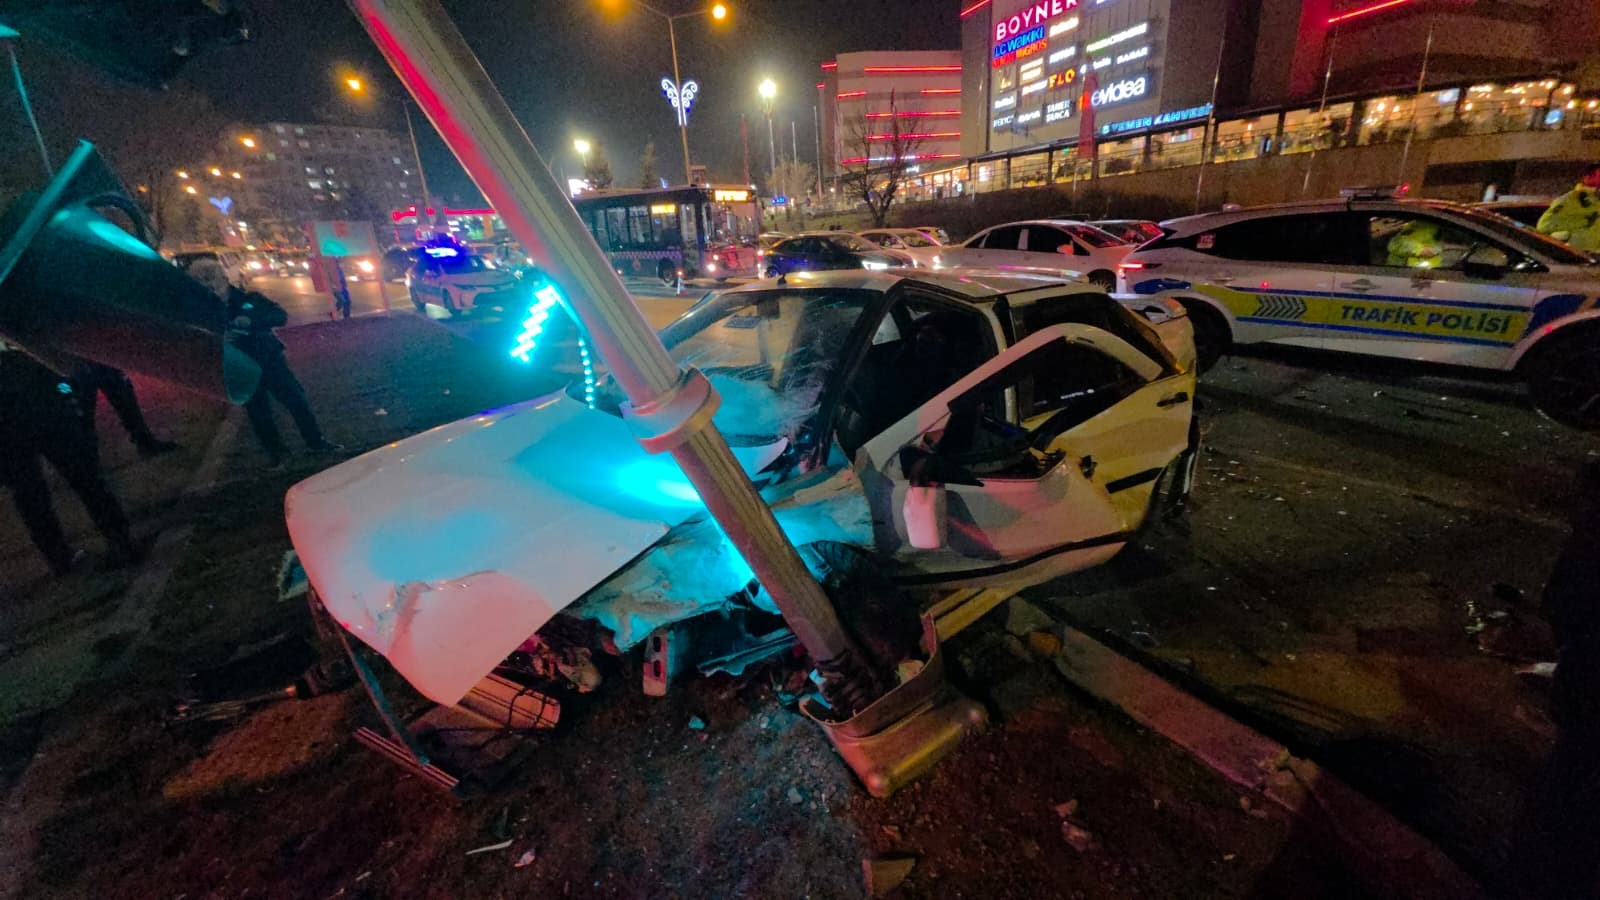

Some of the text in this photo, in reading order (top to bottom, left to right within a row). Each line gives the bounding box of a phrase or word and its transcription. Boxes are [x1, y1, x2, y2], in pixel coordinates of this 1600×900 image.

[1048, 68, 1075, 89] FLO
[1342, 305, 1512, 334] TRAFİK POLİSİ
